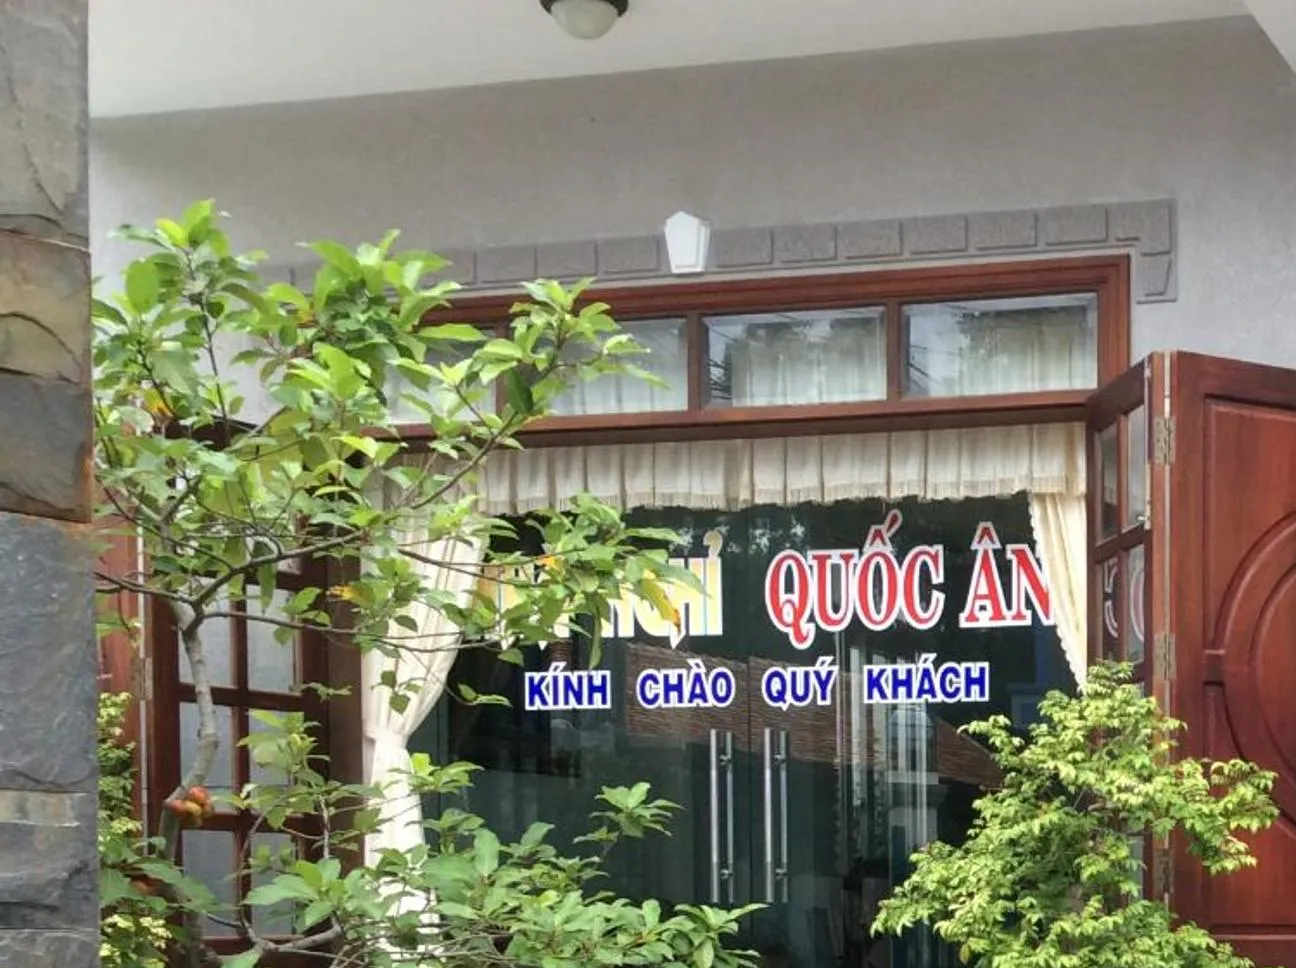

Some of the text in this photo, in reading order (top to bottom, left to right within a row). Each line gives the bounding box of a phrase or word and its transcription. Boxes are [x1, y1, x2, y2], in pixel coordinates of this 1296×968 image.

[763, 509, 945, 649] QUỐC
[959, 521, 1055, 628] ÂN
[525, 653, 989, 711] KÍNH CHÀO QUÝ KHÁCH
